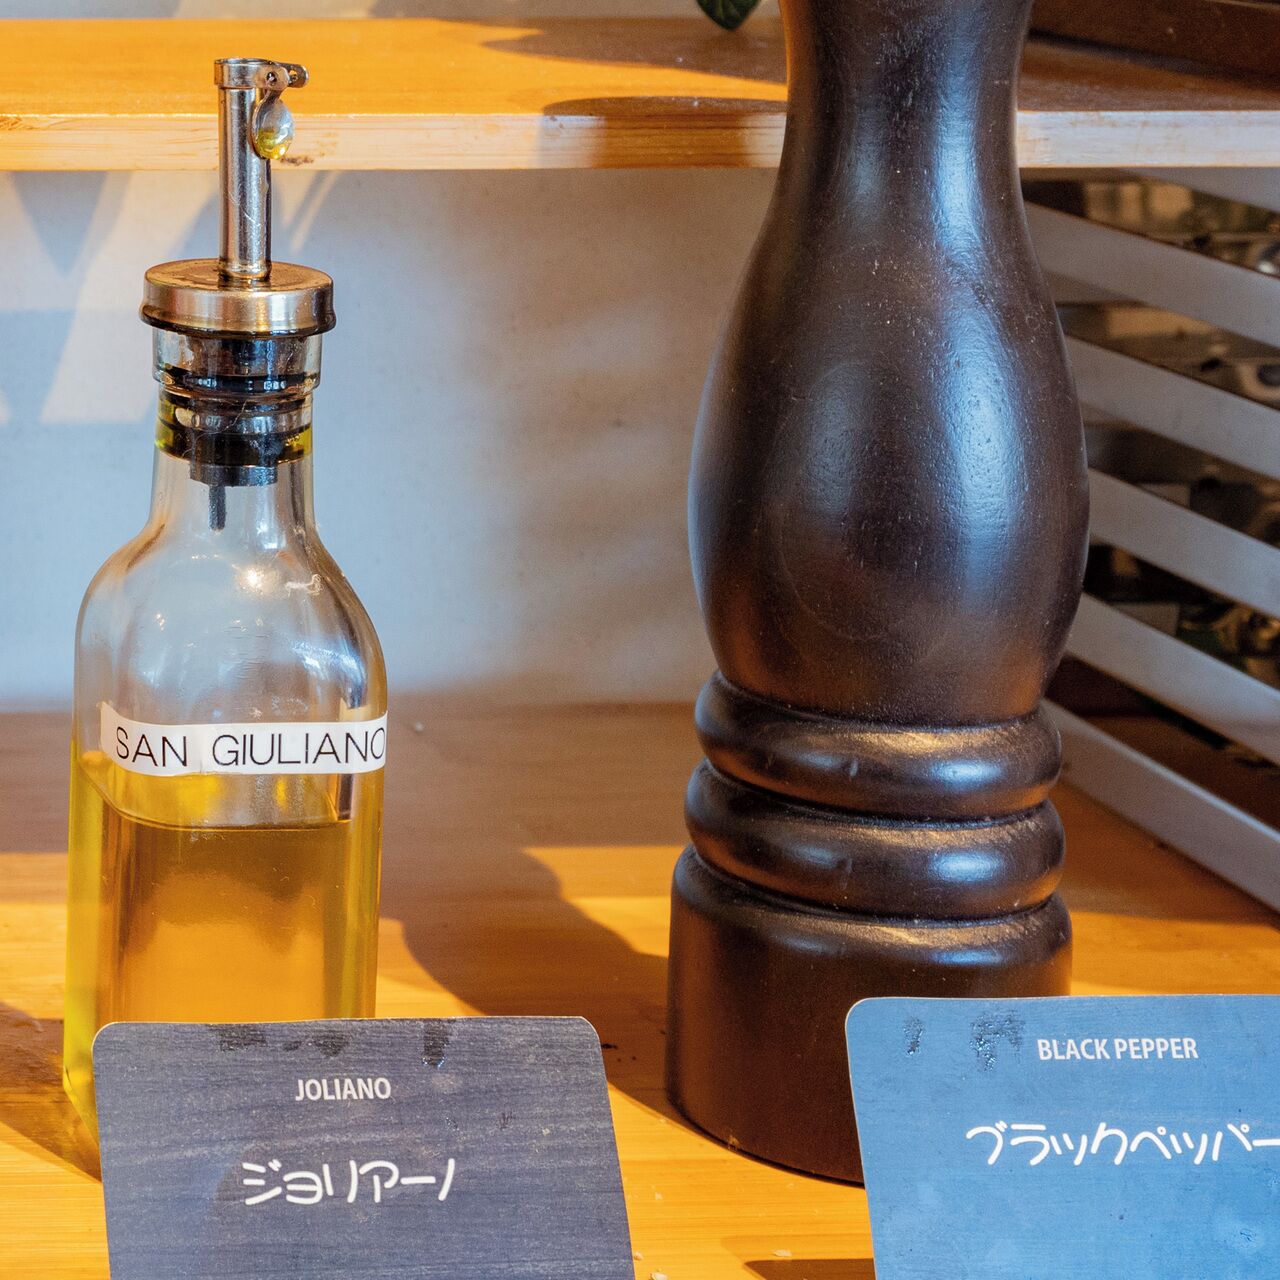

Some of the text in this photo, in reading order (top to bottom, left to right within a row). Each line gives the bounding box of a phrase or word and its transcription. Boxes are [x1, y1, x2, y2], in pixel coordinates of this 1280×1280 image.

[116, 726, 386, 767] SAN GIULIANO
[1037, 1037, 1199, 1060] BLACK PEPPER
[295, 1077, 391, 1101] JOLIANO
